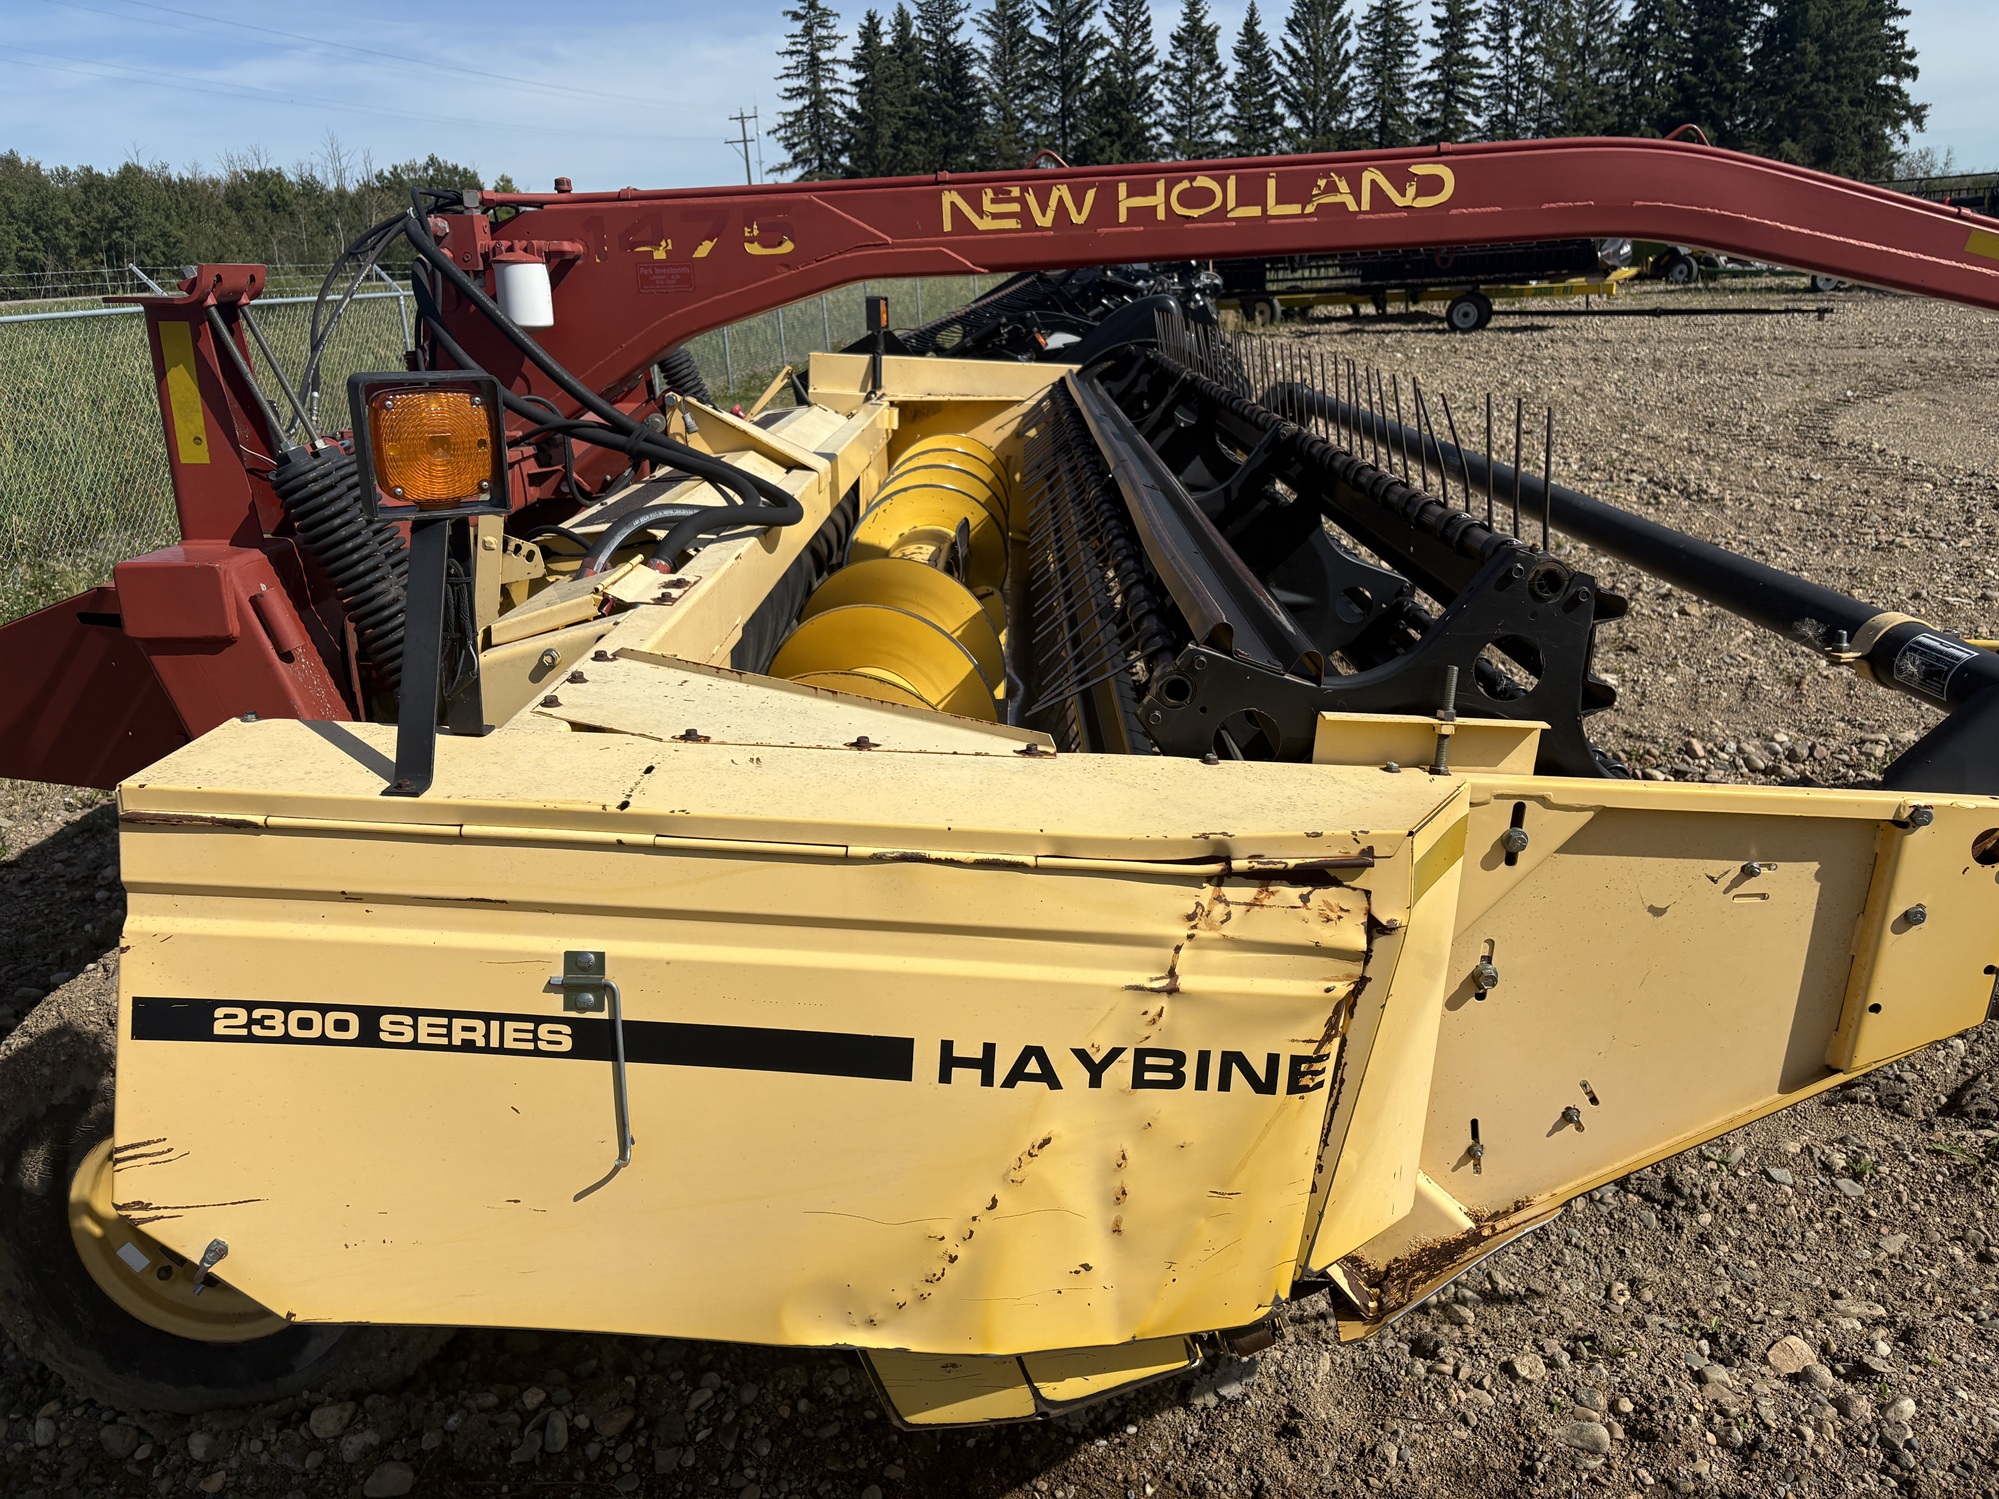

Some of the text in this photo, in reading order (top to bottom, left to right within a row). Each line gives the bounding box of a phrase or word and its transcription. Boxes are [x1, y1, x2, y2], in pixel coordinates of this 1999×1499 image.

[941, 163, 1456, 232] NEW HOLLAND
[581, 207, 795, 263] 1475
[213, 1006, 573, 1053] 2300 SERIES
[938, 1038, 1331, 1097] HAYBINE
